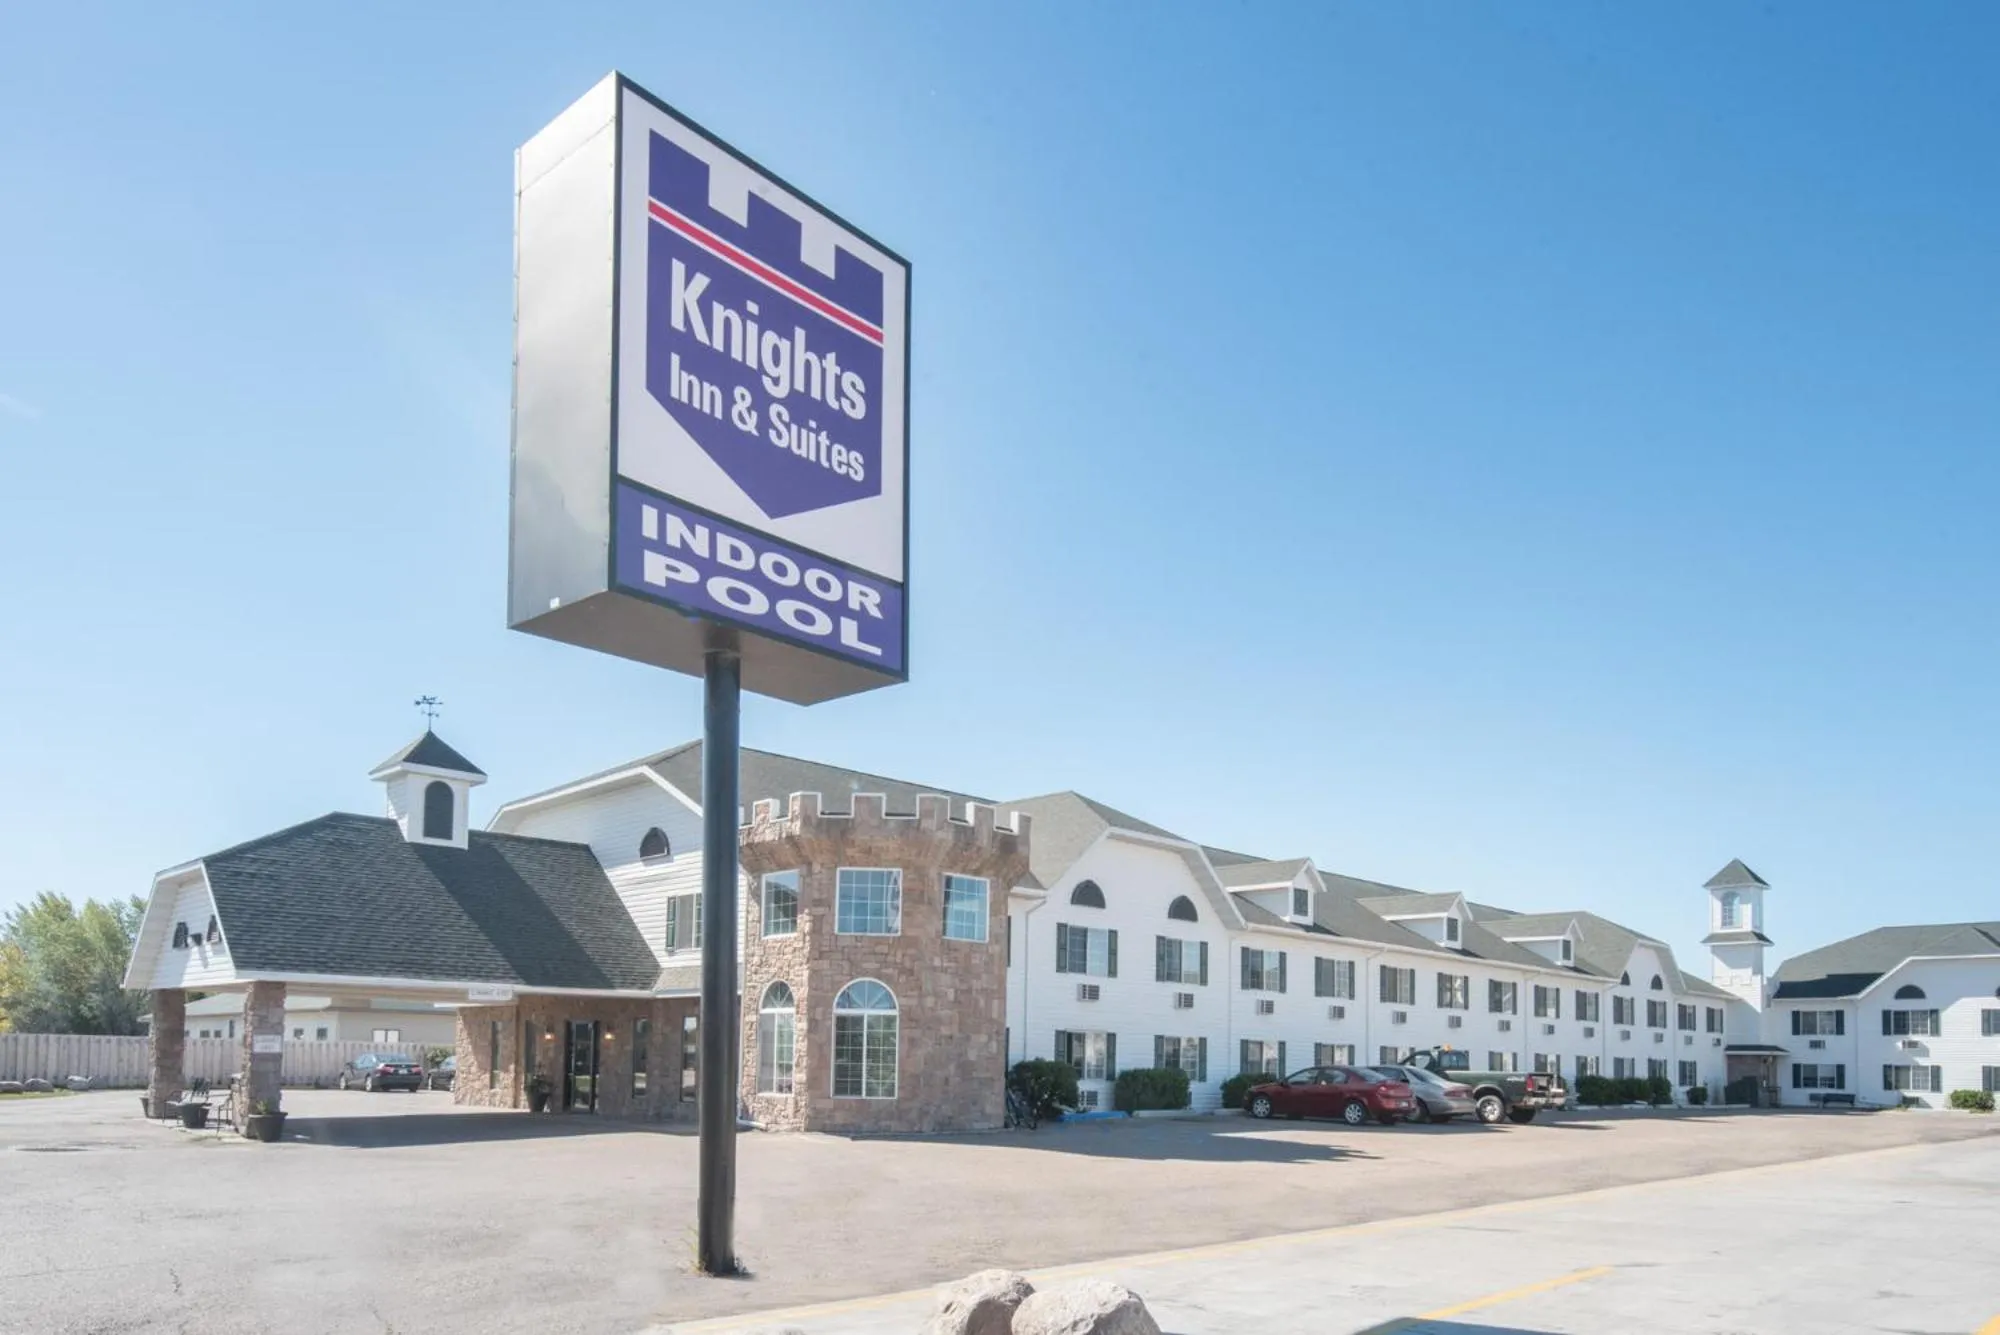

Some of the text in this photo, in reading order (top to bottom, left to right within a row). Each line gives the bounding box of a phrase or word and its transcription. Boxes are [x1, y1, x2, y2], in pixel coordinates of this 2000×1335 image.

[671, 257, 866, 420] Knights
[670, 352, 865, 482] Inn & Suites
[642, 504, 883, 619] INDOOR
[644, 549, 882, 656] POOL
